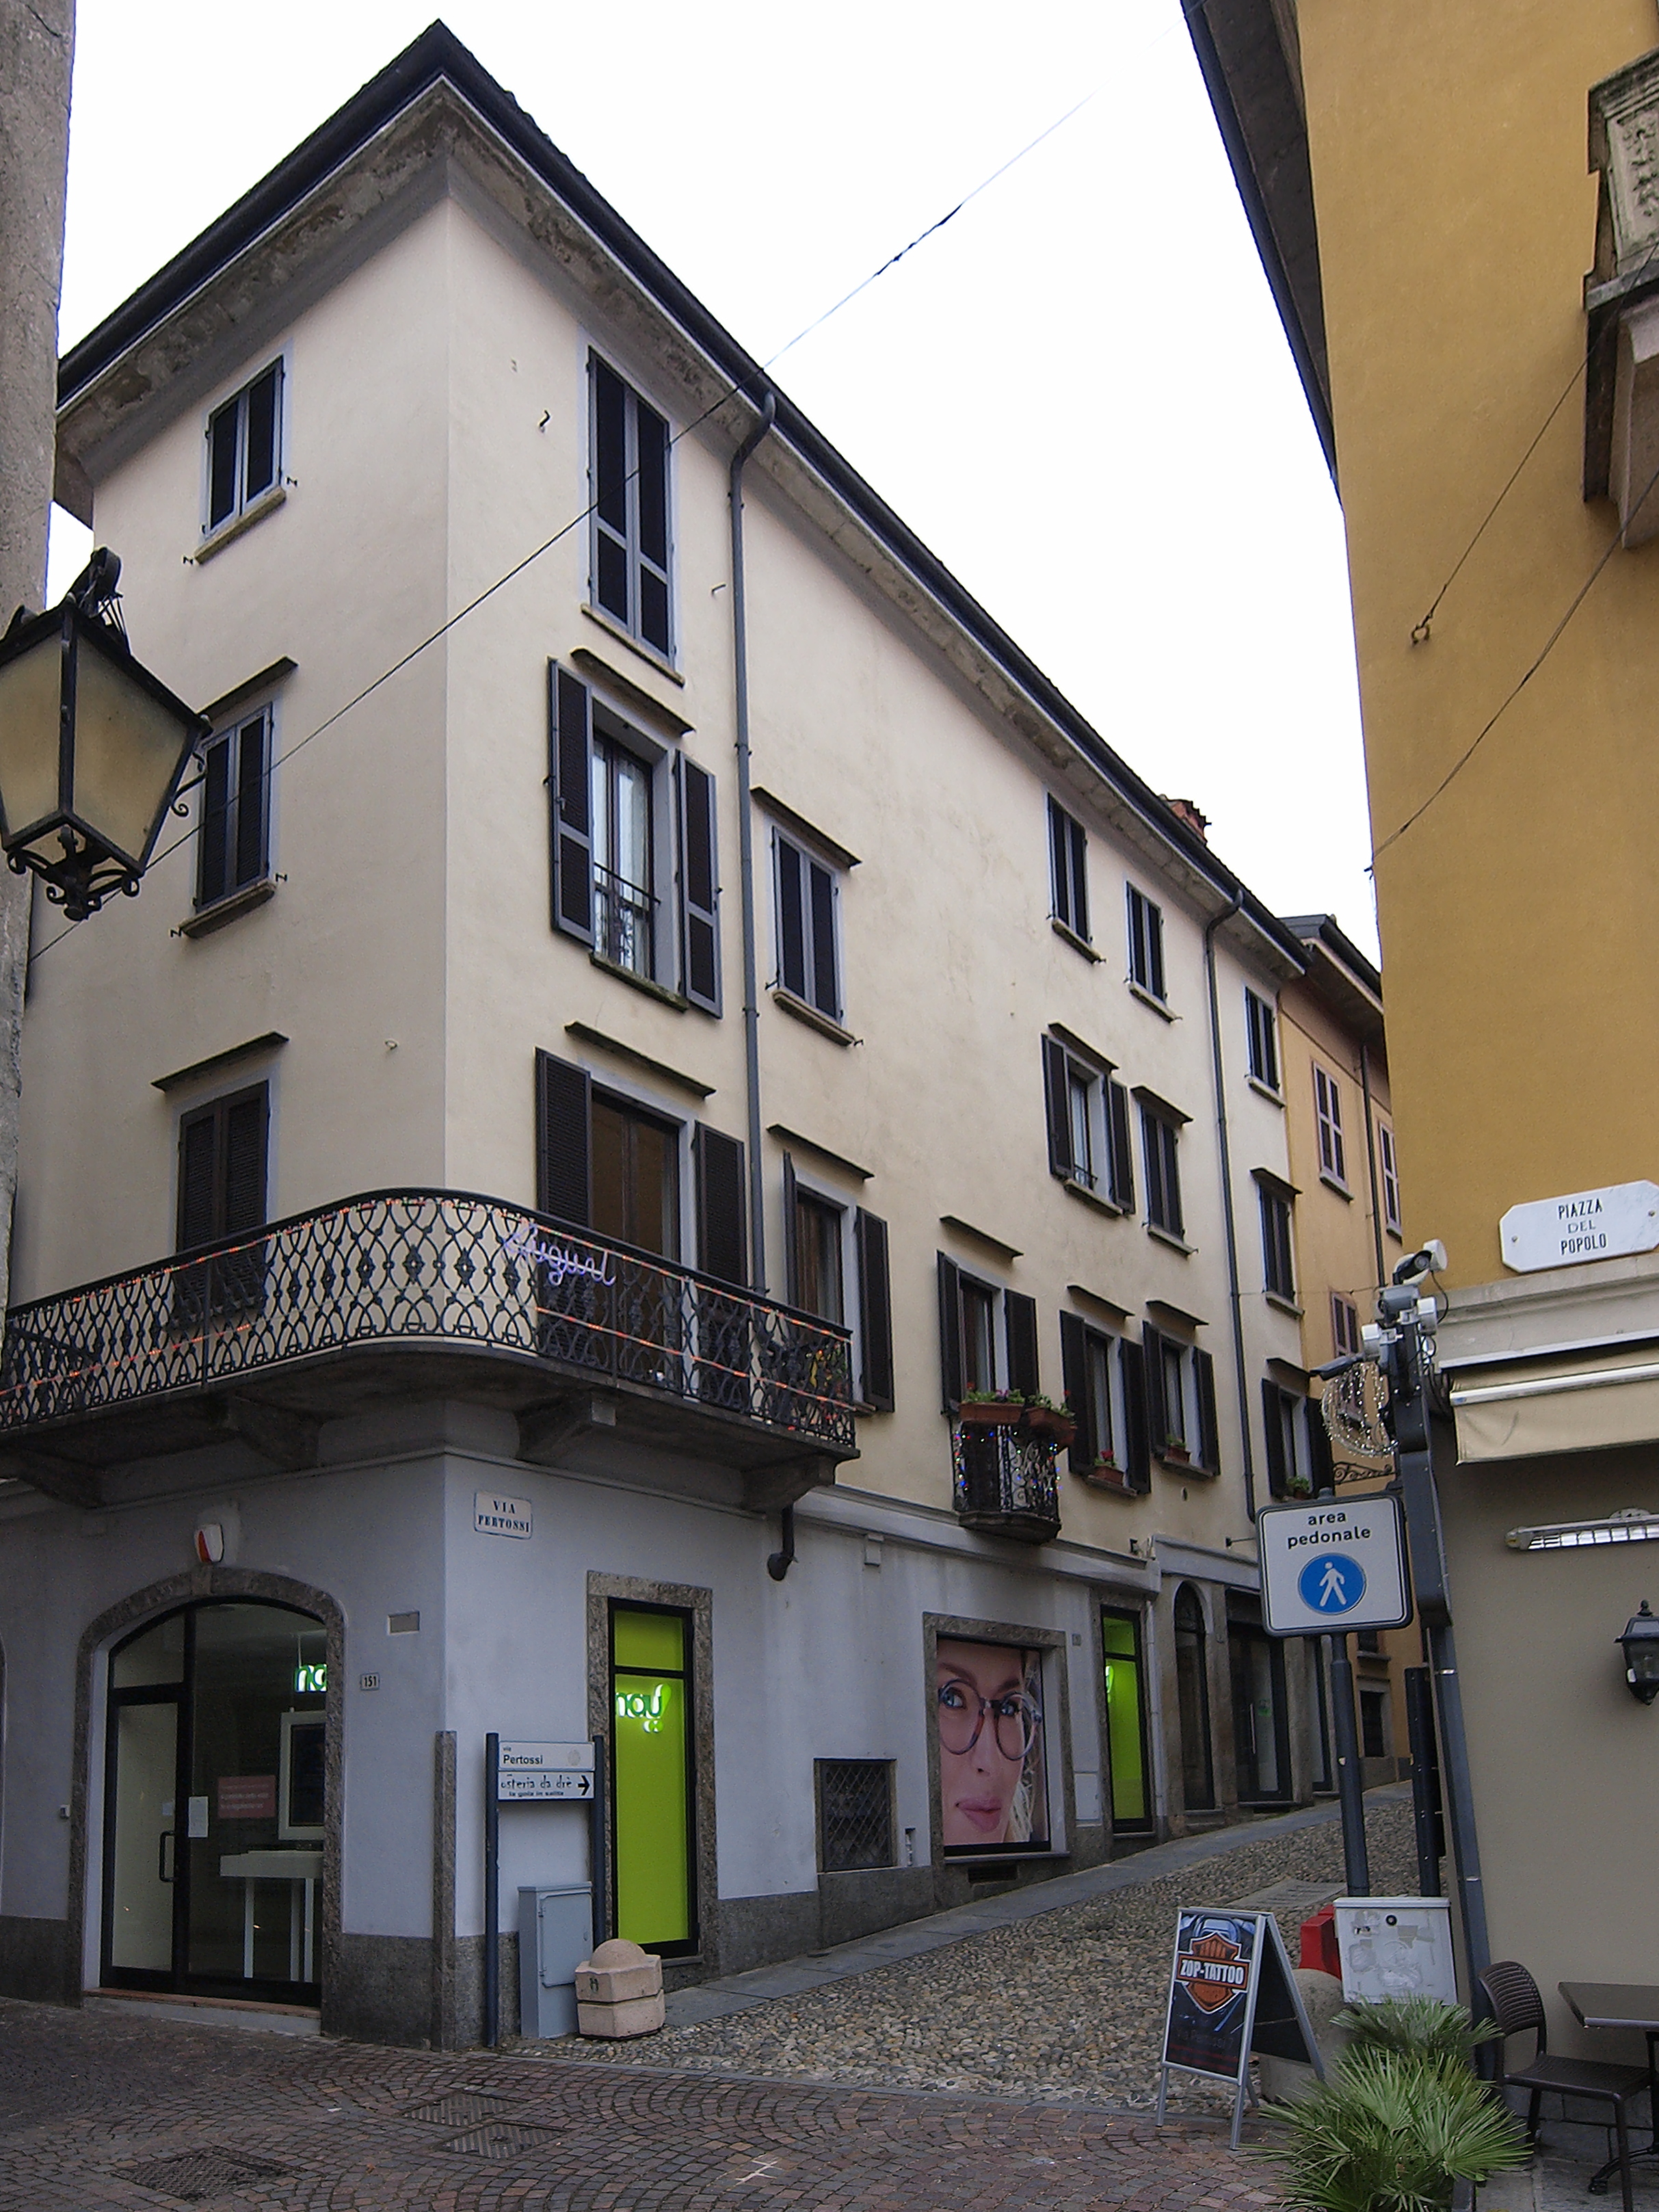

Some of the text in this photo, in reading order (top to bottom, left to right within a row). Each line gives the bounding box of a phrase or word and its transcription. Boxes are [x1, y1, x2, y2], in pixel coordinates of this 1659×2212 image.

[1558, 1198, 1603, 1220] PIAZZA
[1567, 1220, 1596, 1233] DEL
[1561, 1233, 1607, 1255] POPOLO
[492, 1500, 516, 1514] VIA
[478, 1514, 529, 1533] PERTOSSI
[1308, 1512, 1346, 1525] area
[1288, 1526, 1371, 1549] pedonale
[364, 1676, 377, 1687] 151
[503, 1754, 544, 1765] Pertossi
[501, 1774, 535, 1789] osteria
[540, 1774, 551, 1789] da
[1180, 1959, 1245, 1985] ZOP-TATTOO
